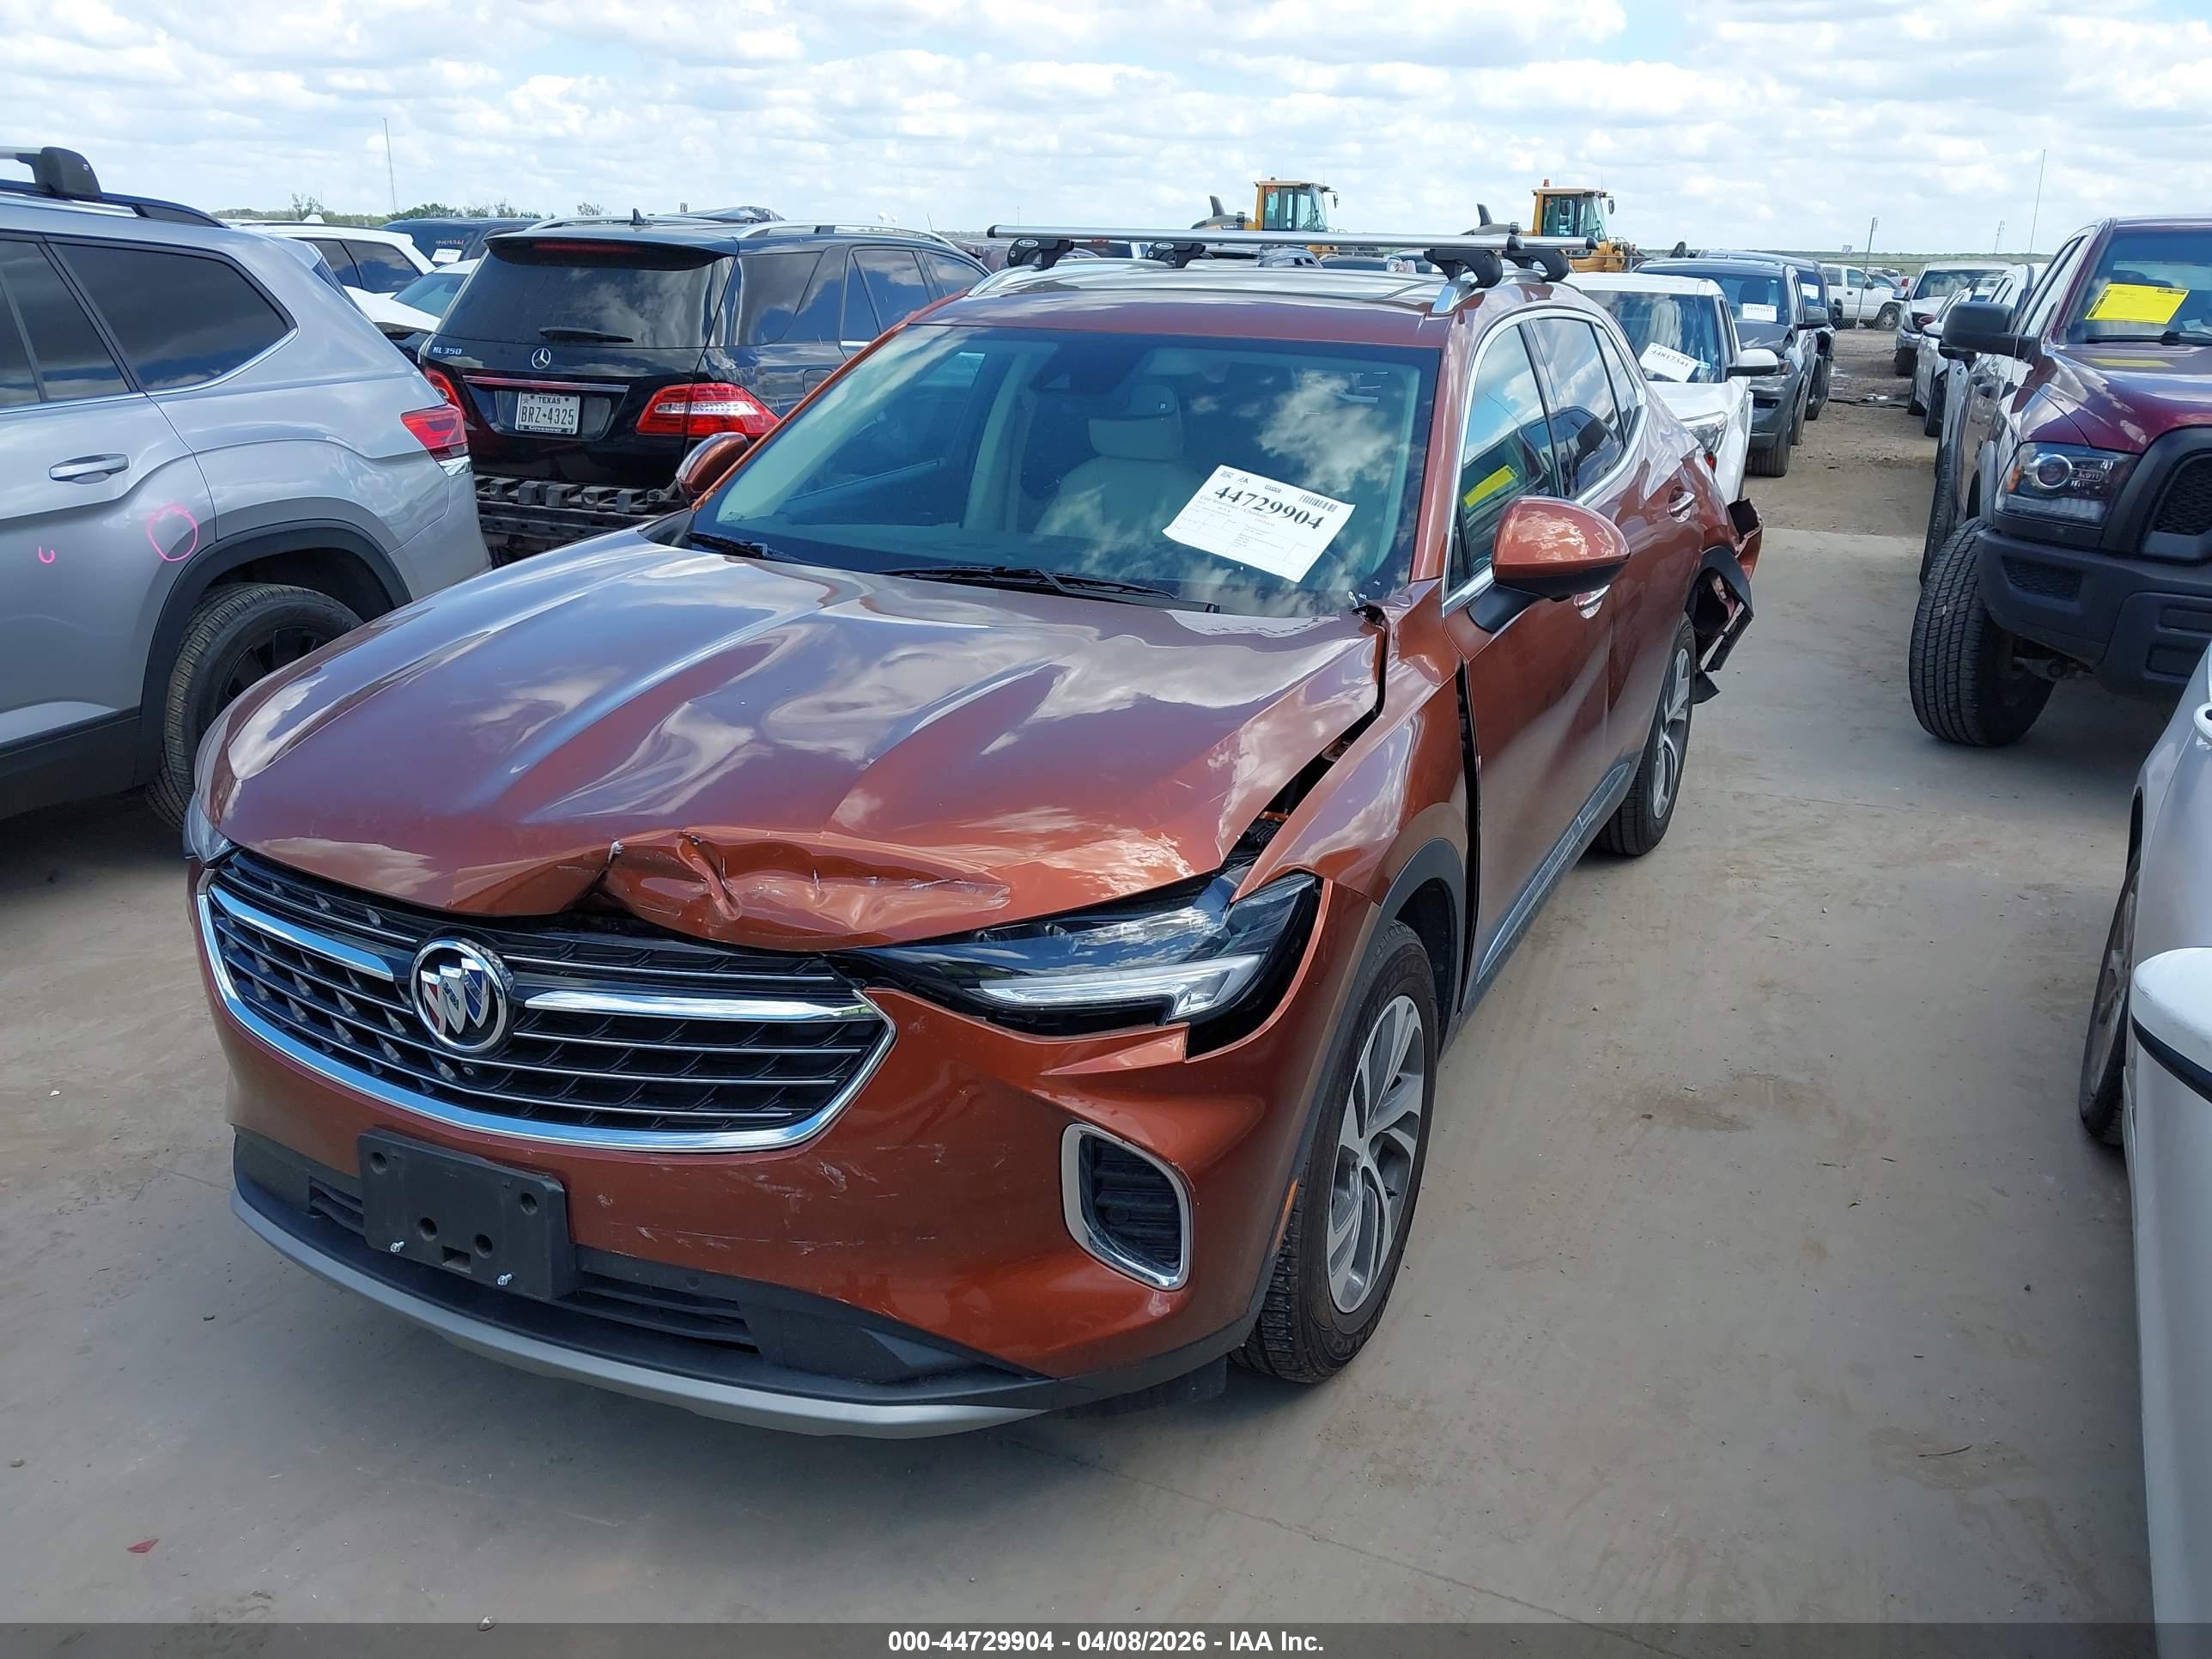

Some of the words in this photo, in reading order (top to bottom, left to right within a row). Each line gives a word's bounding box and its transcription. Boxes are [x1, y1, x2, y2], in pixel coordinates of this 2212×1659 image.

[443, 347, 463, 356] 350
[538, 396, 561, 404] TEXAS
[1214, 486, 1325, 530] 44729904
